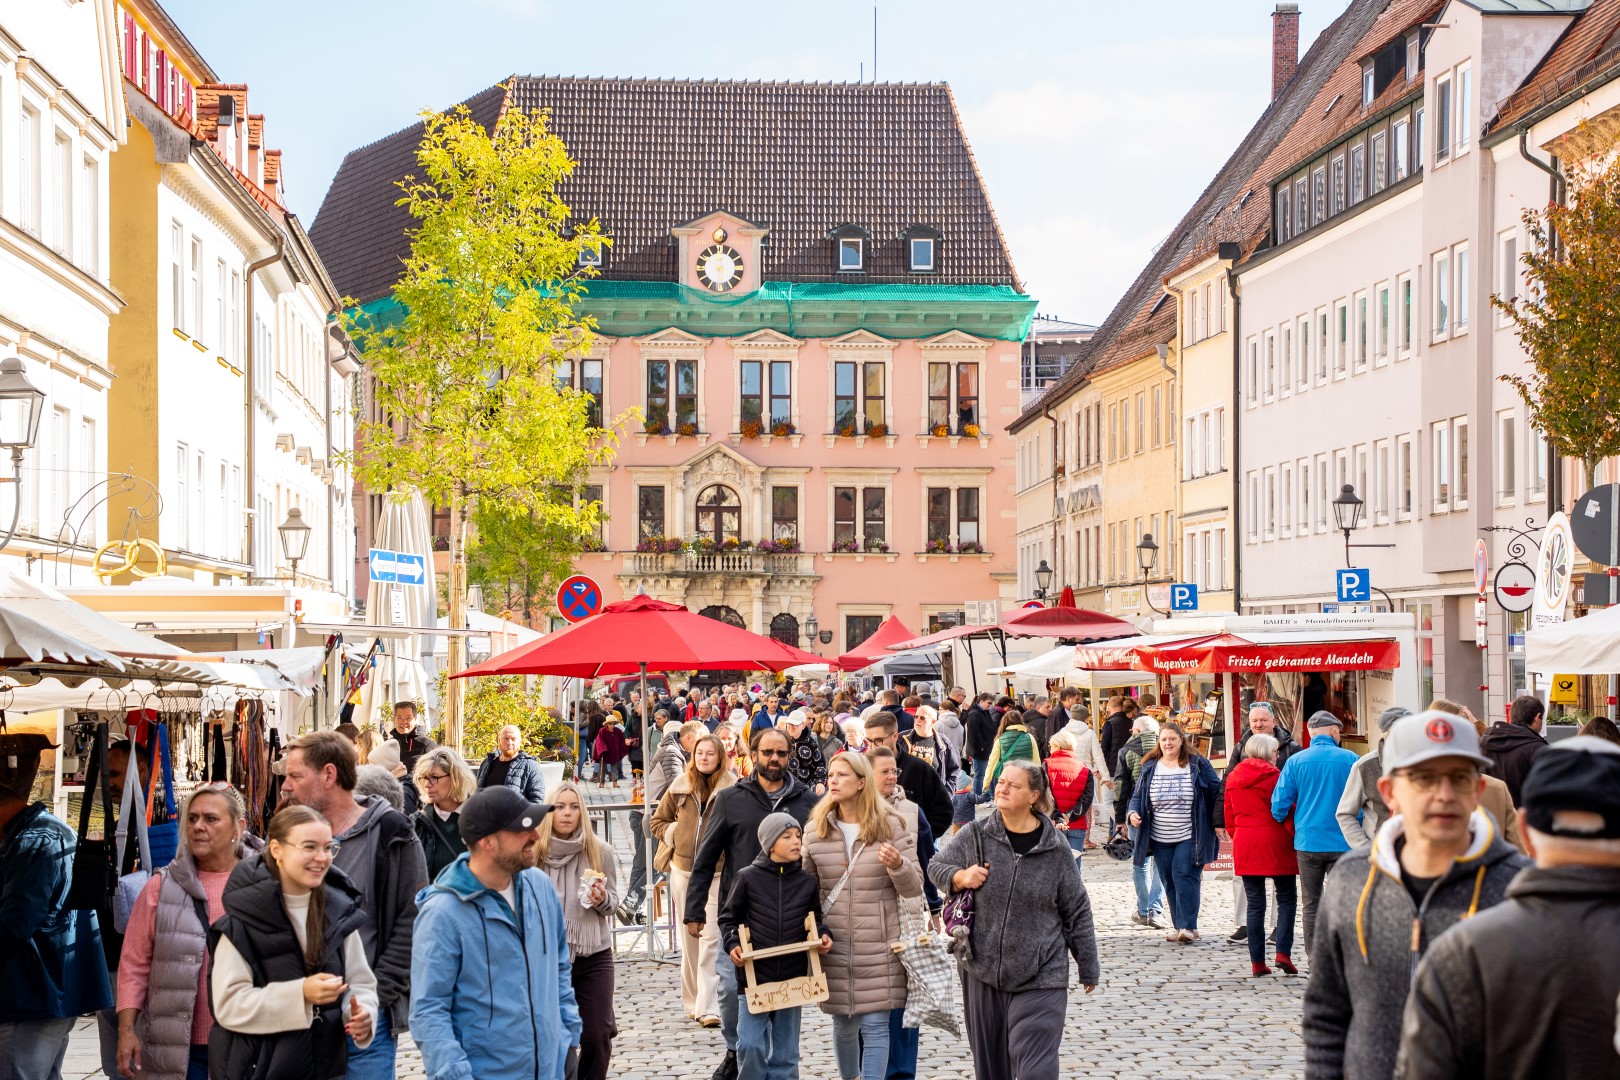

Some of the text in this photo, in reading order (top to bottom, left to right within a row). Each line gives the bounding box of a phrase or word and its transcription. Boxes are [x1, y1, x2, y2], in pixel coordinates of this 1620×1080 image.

[1341, 572, 1360, 599] P
[1174, 587, 1190, 608] P
[1153, 657, 1199, 671] Magenbrot
[1228, 652, 1374, 669] Frisch gebrannte Mandeln
